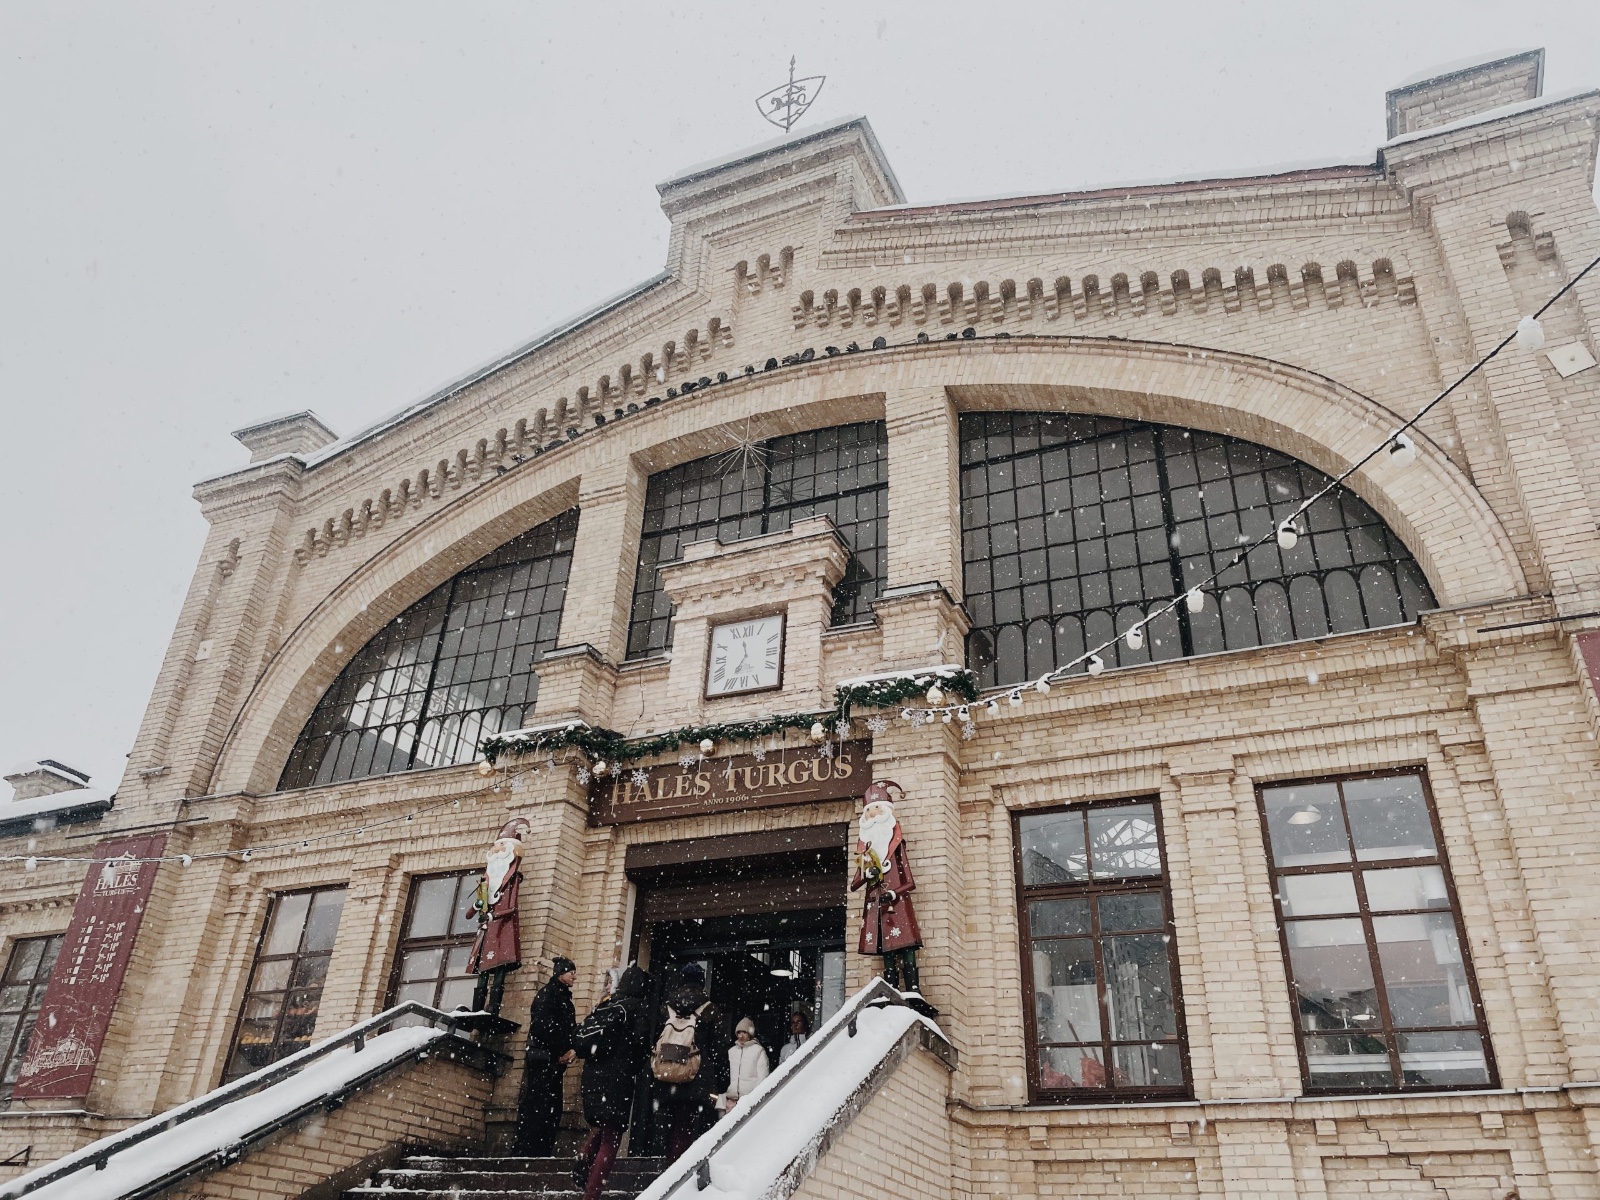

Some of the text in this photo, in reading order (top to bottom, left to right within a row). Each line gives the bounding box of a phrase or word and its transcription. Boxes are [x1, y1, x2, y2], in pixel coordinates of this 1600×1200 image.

[743, 625, 754, 638] XII
[609, 754, 853, 806] HALĖS TURGUS
[703, 793, 747, 806] ANNO 1906
